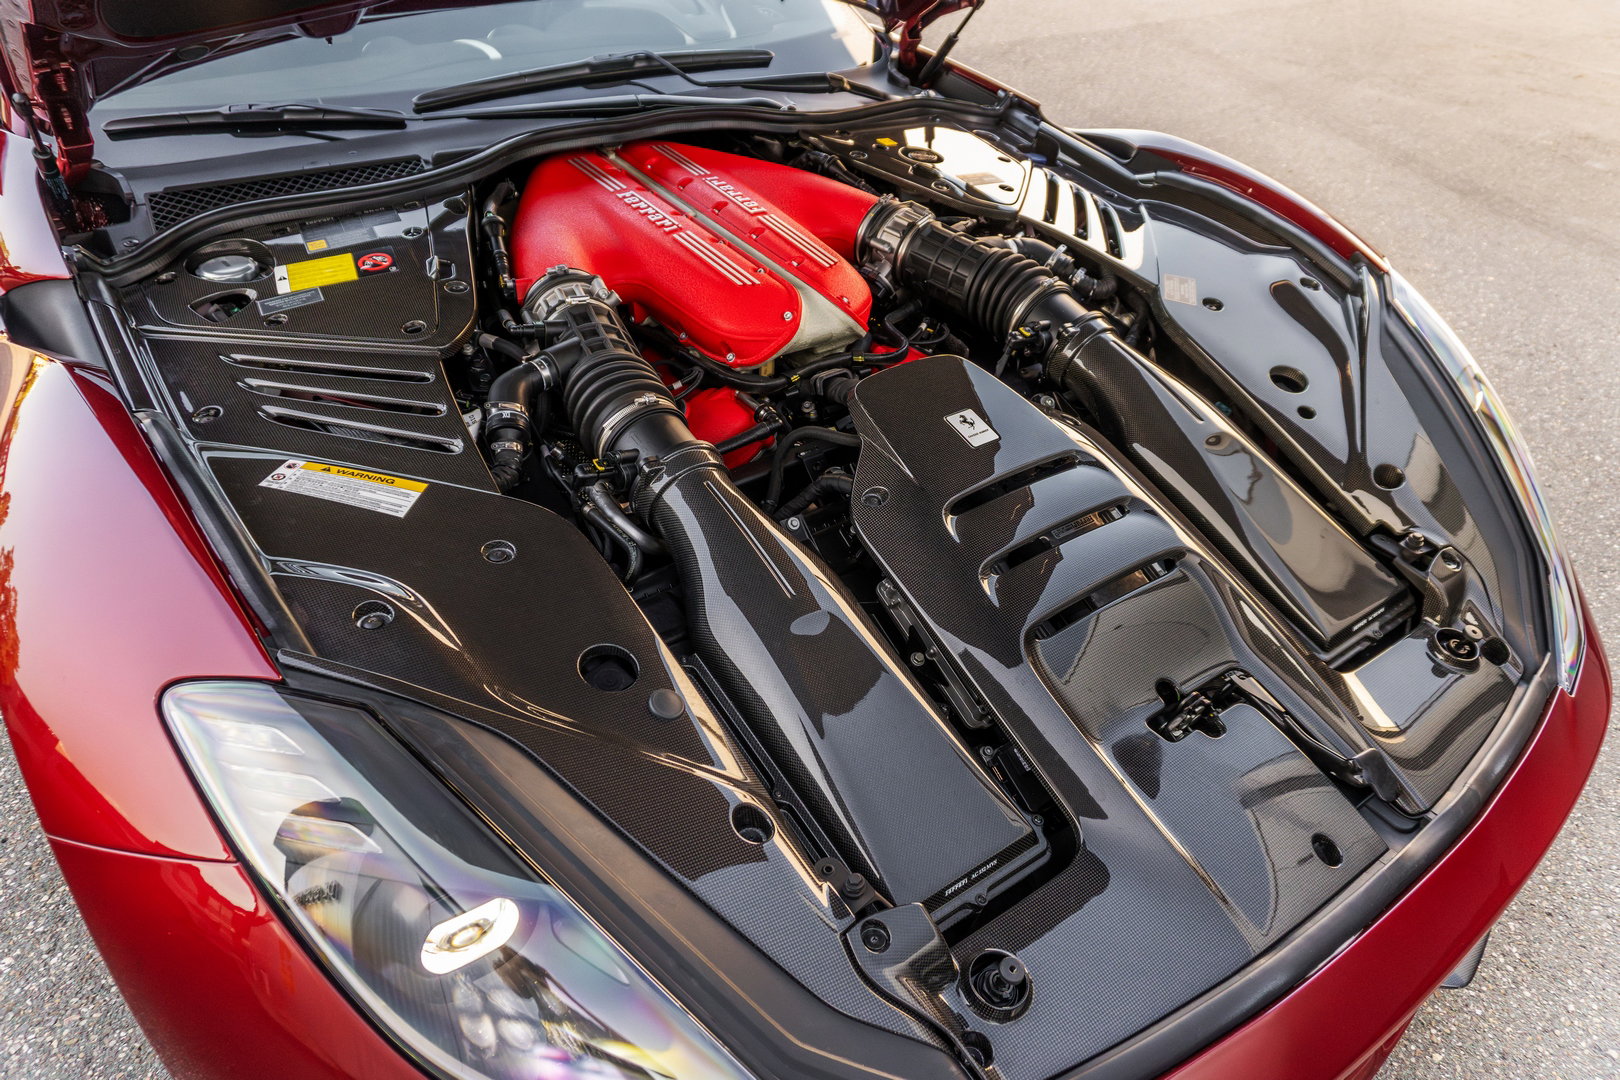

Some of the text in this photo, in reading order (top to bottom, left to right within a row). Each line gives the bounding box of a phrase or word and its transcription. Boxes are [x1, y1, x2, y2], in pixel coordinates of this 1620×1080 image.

[616, 190, 683, 233] Ferrari
[702, 175, 768, 215] Ferrari
[336, 468, 396, 486] WARNING
